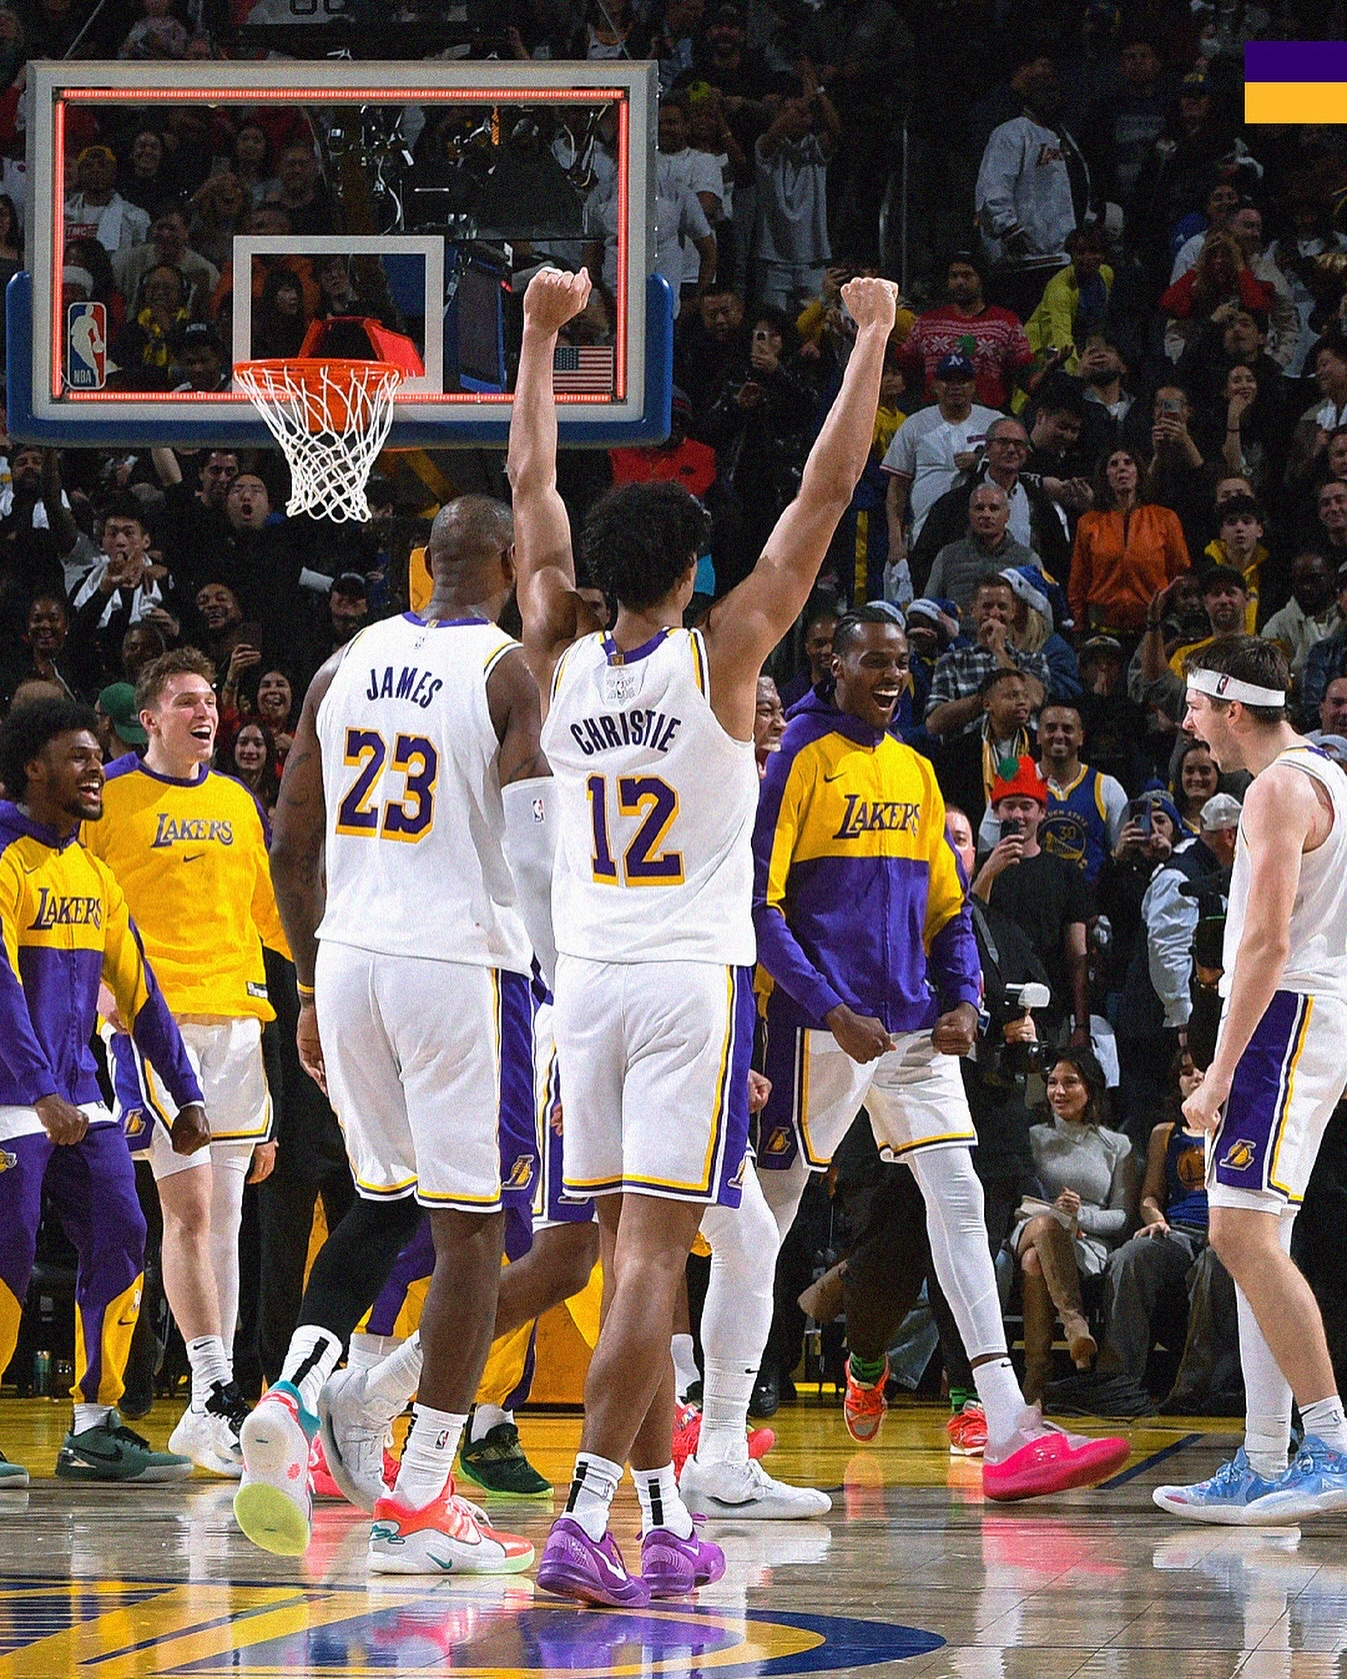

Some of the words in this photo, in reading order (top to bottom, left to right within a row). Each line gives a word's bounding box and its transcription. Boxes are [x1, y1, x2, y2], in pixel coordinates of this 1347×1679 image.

[74, 369, 92, 384] NBA
[366, 666, 443, 709] JAMES
[570, 709, 682, 756] CHRISTIE
[335, 726, 441, 844] 23
[150, 812, 234, 848] LAKERS
[586, 772, 685, 887] 12
